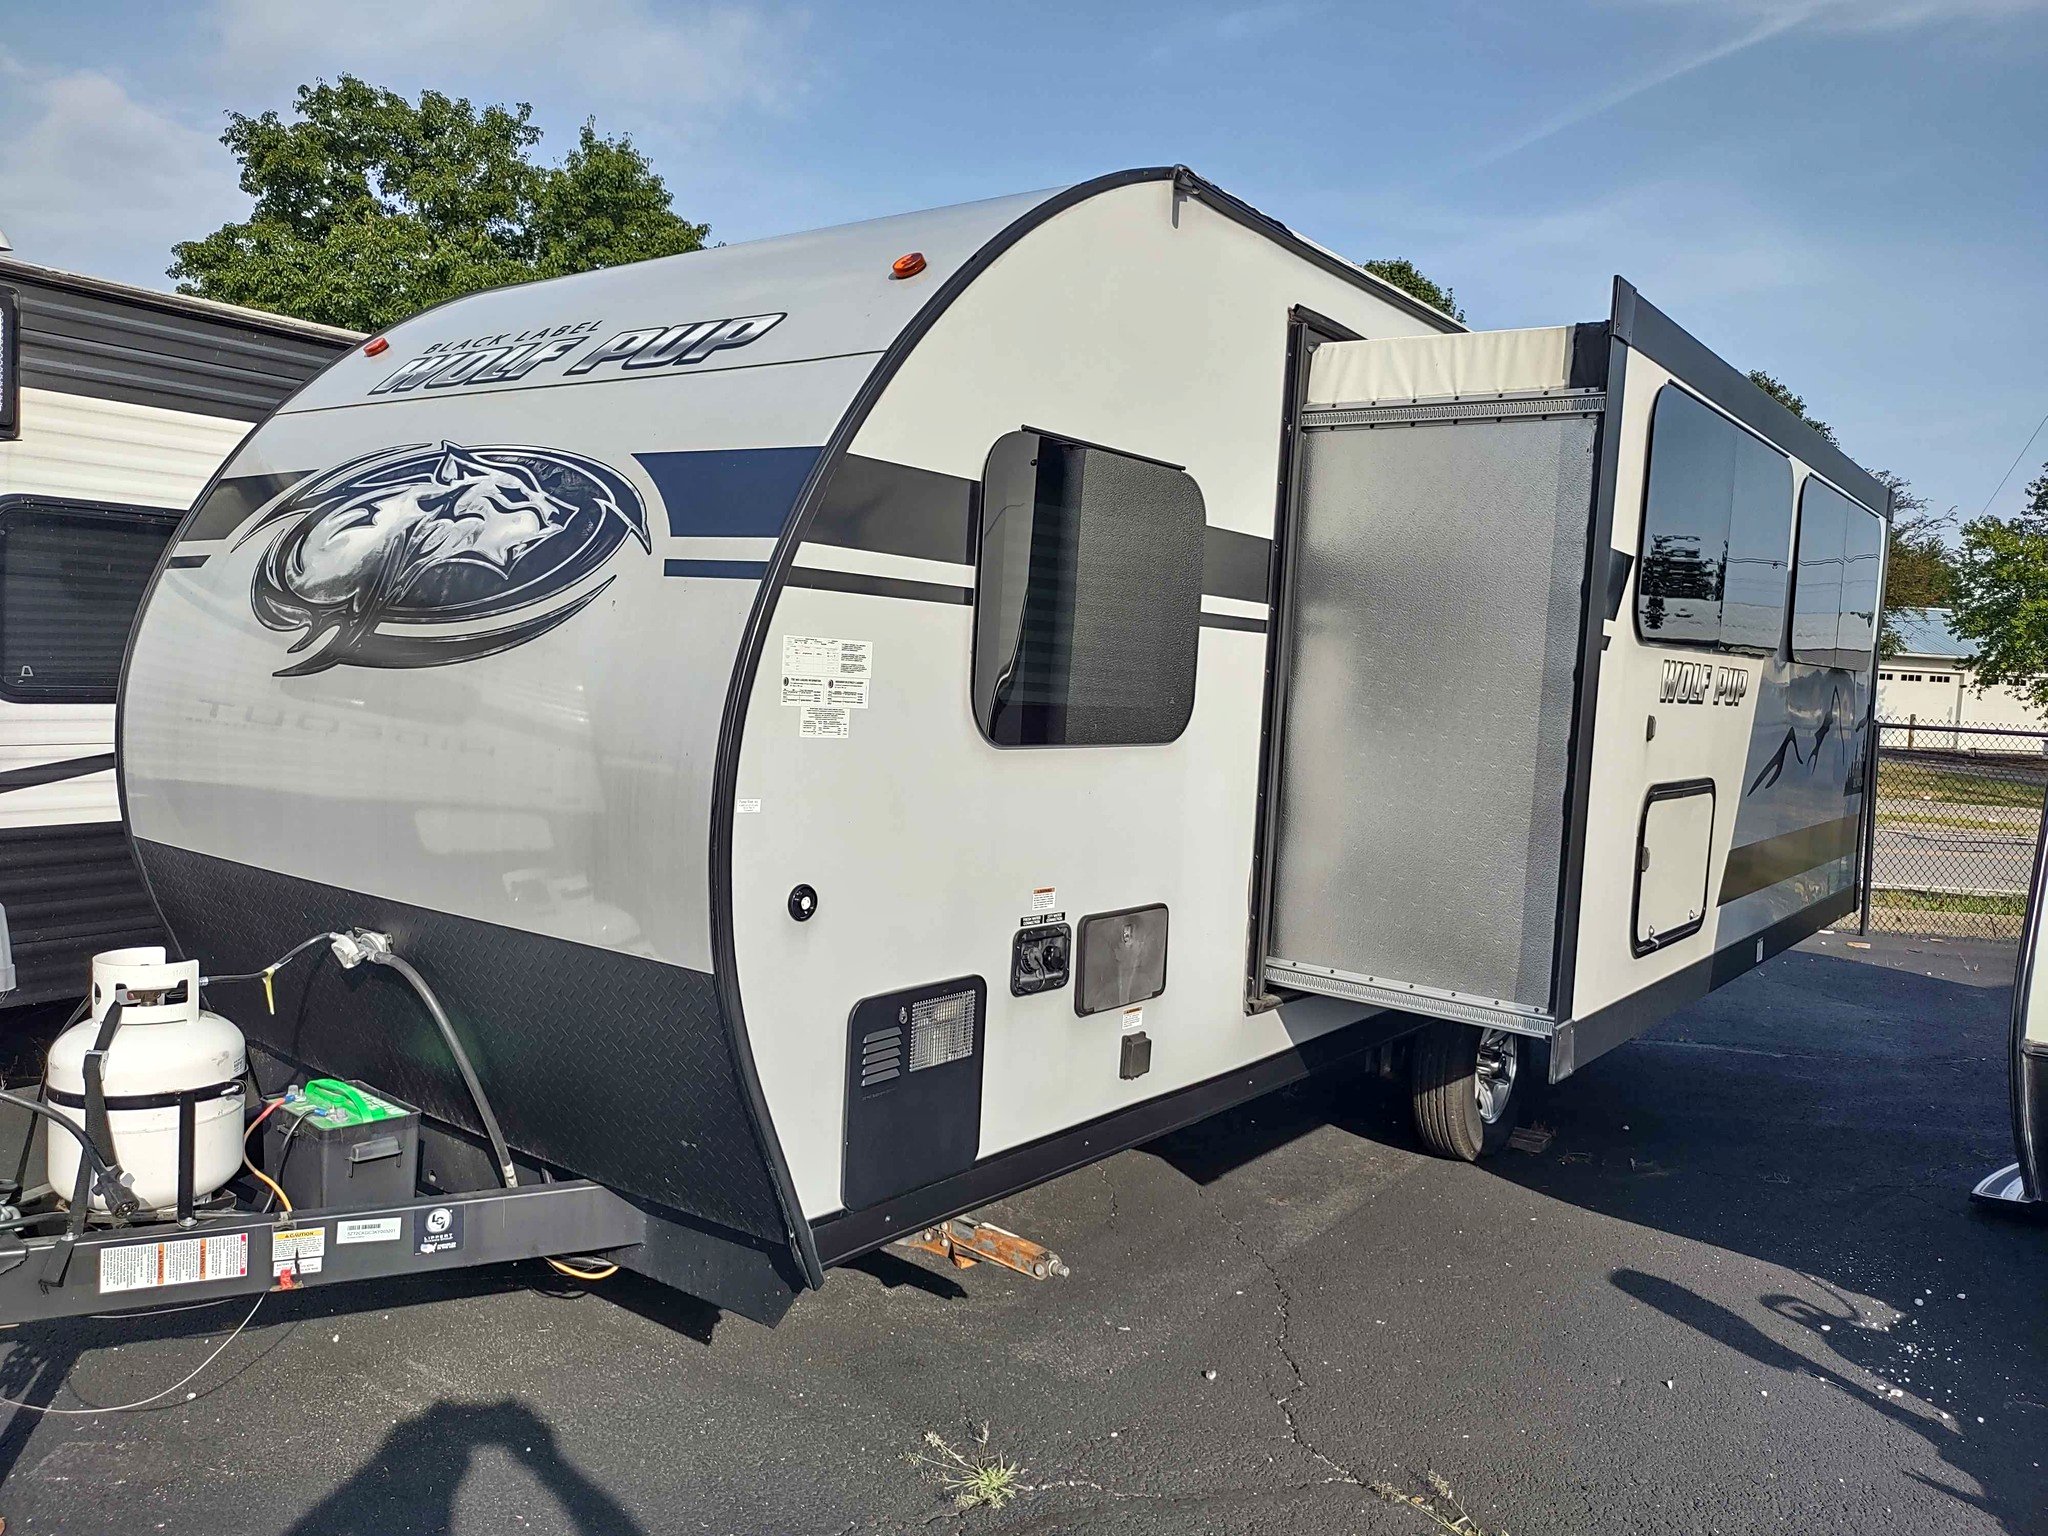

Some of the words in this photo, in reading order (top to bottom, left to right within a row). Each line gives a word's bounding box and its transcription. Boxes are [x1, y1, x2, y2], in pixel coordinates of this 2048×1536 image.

[367, 336, 590, 396] WOLF
[562, 312, 788, 376] PUP
[424, 332, 511, 355] BLACK
[518, 319, 603, 341] LABEL
[1659, 659, 1713, 705] WOLF
[1712, 666, 1749, 707] PUP
